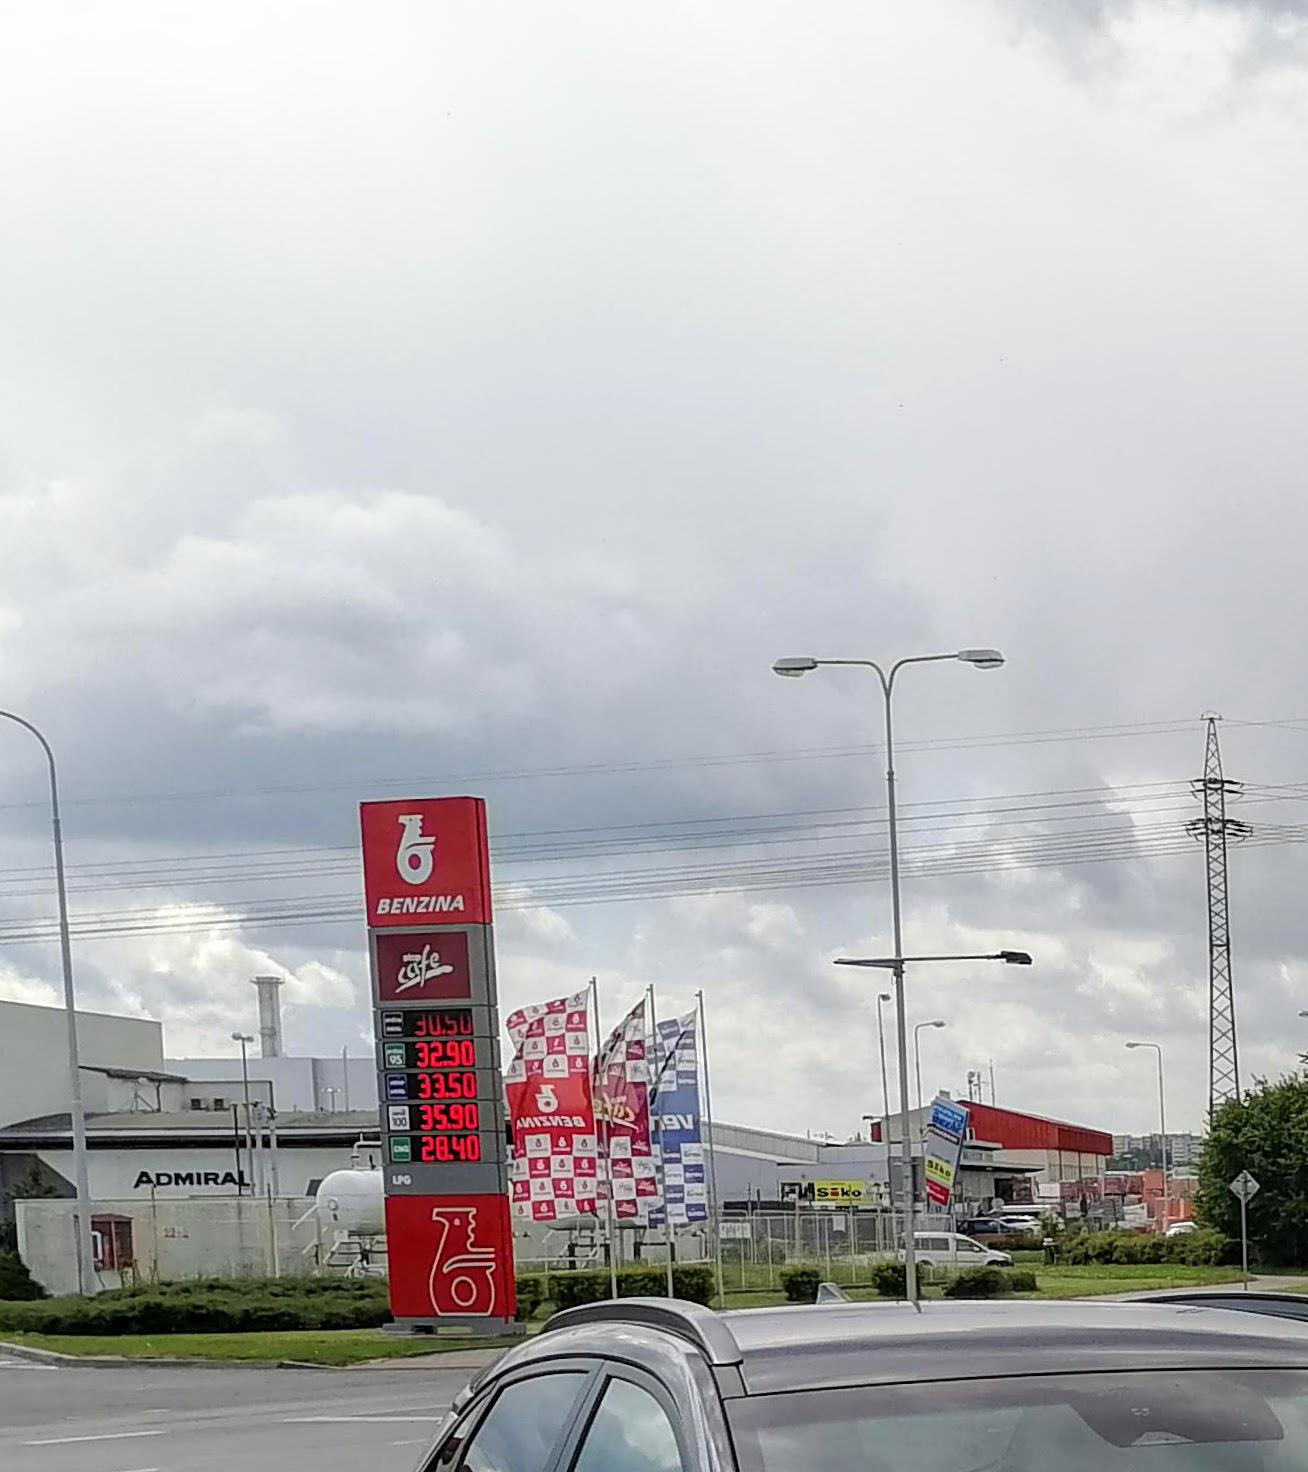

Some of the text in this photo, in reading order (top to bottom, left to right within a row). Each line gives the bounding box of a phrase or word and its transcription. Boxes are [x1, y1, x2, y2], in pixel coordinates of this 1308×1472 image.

[376, 894, 465, 915] BENZINA
[417, 1072, 478, 1099] 33.50
[419, 1103, 479, 1131] 35.90
[134, 1170, 251, 1189] ADMIRAL
[392, 1175, 412, 1185] LPG
